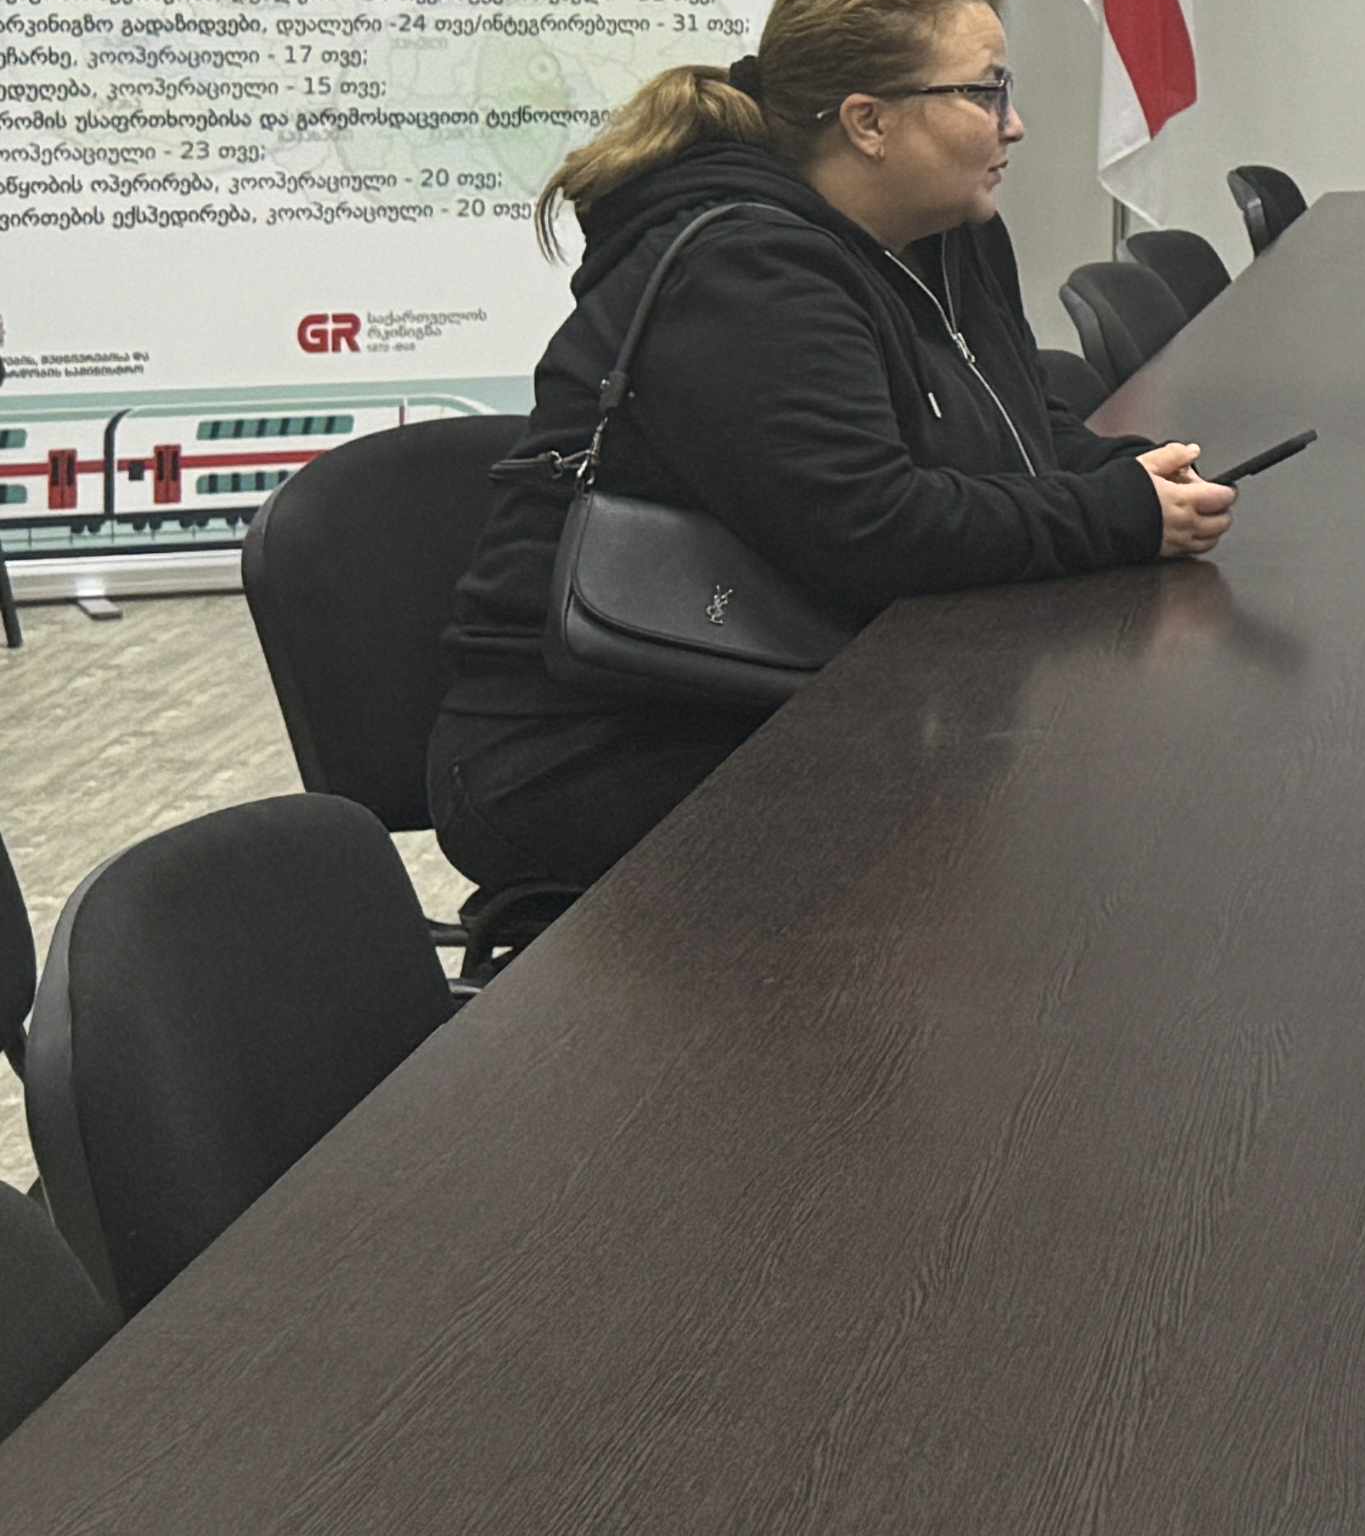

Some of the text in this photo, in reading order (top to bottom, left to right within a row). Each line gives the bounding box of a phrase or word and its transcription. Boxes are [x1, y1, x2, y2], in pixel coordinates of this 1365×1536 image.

[275, 12, 383, 38] დუალური
[388, 12, 427, 33] -24
[433, 11, 651, 38] თვე/ინტეგრირებული
[672, 12, 699, 33] 31
[85, 44, 261, 71] კოოპერაციული
[284, 44, 313, 65] 17
[105, 75, 279, 102] კოოპერაციული
[303, 75, 332, 97] 15
[73, 107, 253, 135] უსაფრთხოებისა
[258, 112, 290, 132] და
[294, 106, 480, 134] გარემოსდაცვითი
[179, 139, 210, 161] 23
[227, 170, 398, 196] კოოპერაციული
[420, 167, 450, 188] 20
[265, 200, 434, 227] კოოპერაციული
[456, 197, 486, 218] 20
[492, 200, 535, 221] თვე
[296, 313, 361, 354] GR
